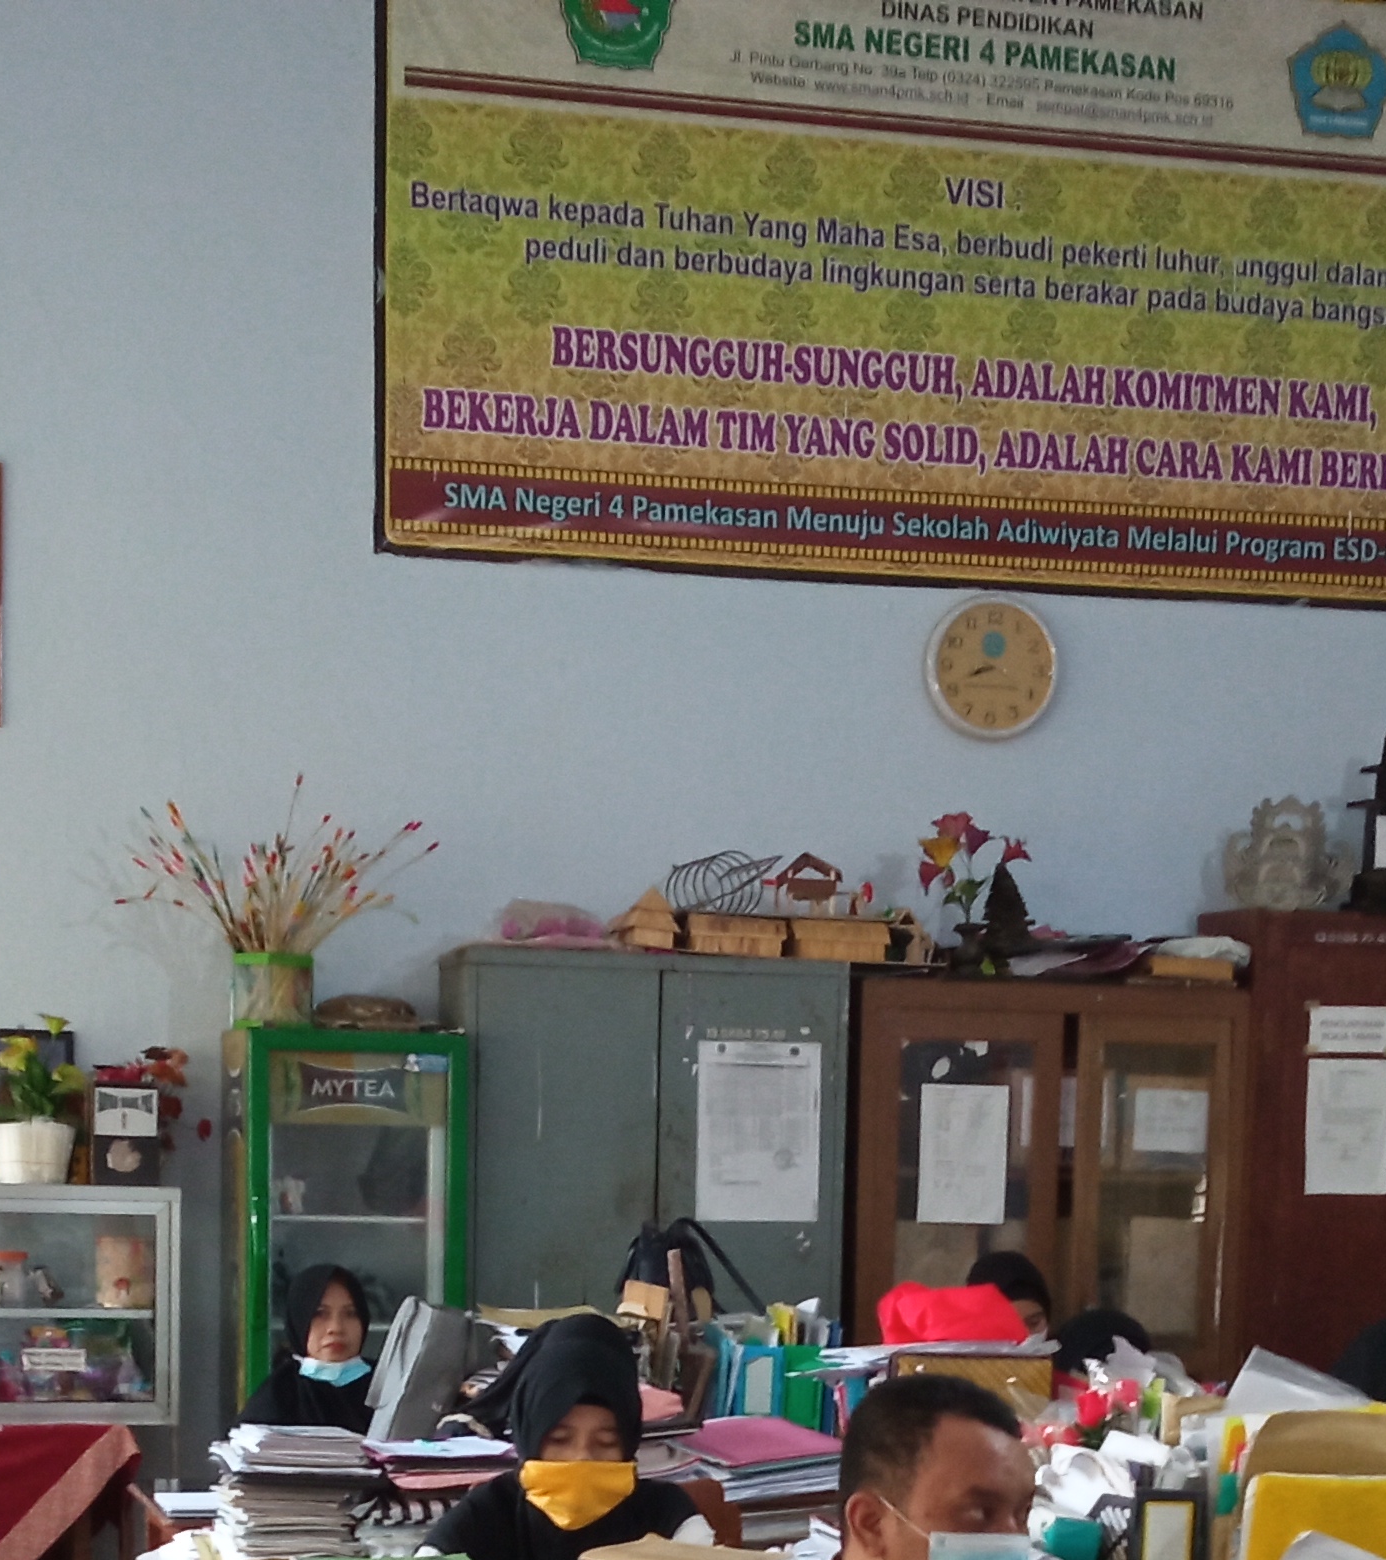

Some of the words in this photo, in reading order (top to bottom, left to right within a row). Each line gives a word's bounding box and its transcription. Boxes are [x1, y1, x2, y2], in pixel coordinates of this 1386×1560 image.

[794, 20, 855, 51] SMA
[865, 26, 970, 63] NEGERI
[979, 38, 995, 66] 4
[1005, 40, 1176, 83] PAMEKASAN
[882, 0, 950, 24] DINAS
[957, 7, 1094, 39] PENDIDIKAN
[942, 70, 987, 88] (0324)
[1044, 79, 1123, 100] Pamekasan
[944, 177, 1005, 209] VISI
[411, 180, 539, 223] Bertaqwa
[548, 193, 645, 230] kepada
[654, 201, 734, 236] Tuhan
[743, 211, 809, 249] Yang
[817, 216, 885, 250] Maha
[894, 224, 949, 257] Esa,
[956, 229, 1054, 264] berbudi
[1060, 241, 1148, 271] pekerti
[1156, 245, 1226, 280] luhur,
[1235, 256, 1319, 288] unggul
[525, 235, 608, 265] peduli
[616, 240, 665, 270] dan
[675, 245, 813, 286] berbudaya
[822, 257, 965, 297] lingkungan
[974, 271, 1036, 300] serta
[1045, 277, 1139, 310] berakar
[1147, 284, 1208, 315] pada
[1215, 288, 1304, 325] budaya
[550, 324, 964, 404] BERSUNGGUH-SUNGGUH,
[971, 357, 1107, 407] ADALAH
[1113, 367, 1282, 418] KOMITMEN
[1288, 379, 1378, 431] KAMI,
[422, 388, 582, 441] BEKERJA
[589, 398, 708, 447] DALAM
[716, 409, 777, 453] TIM
[783, 412, 876, 459] YANG
[883, 421, 987, 476] SOLID,
[993, 429, 1130, 475] ADALAH
[1135, 438, 1223, 483] CARA
[1231, 442, 1314, 487] KAMI
[444, 481, 507, 513] SMA
[514, 487, 602, 523] Negeri
[608, 494, 625, 519] 4
[632, 495, 779, 531] Pamekasan
[786, 504, 886, 538] Menuju
[892, 511, 991, 541] Sekolah
[996, 515, 1120, 555] Adiwiyata
[1127, 523, 1220, 555] Melalui
[1225, 531, 1327, 566] Program
[311, 1078, 396, 1099] MYTEA
